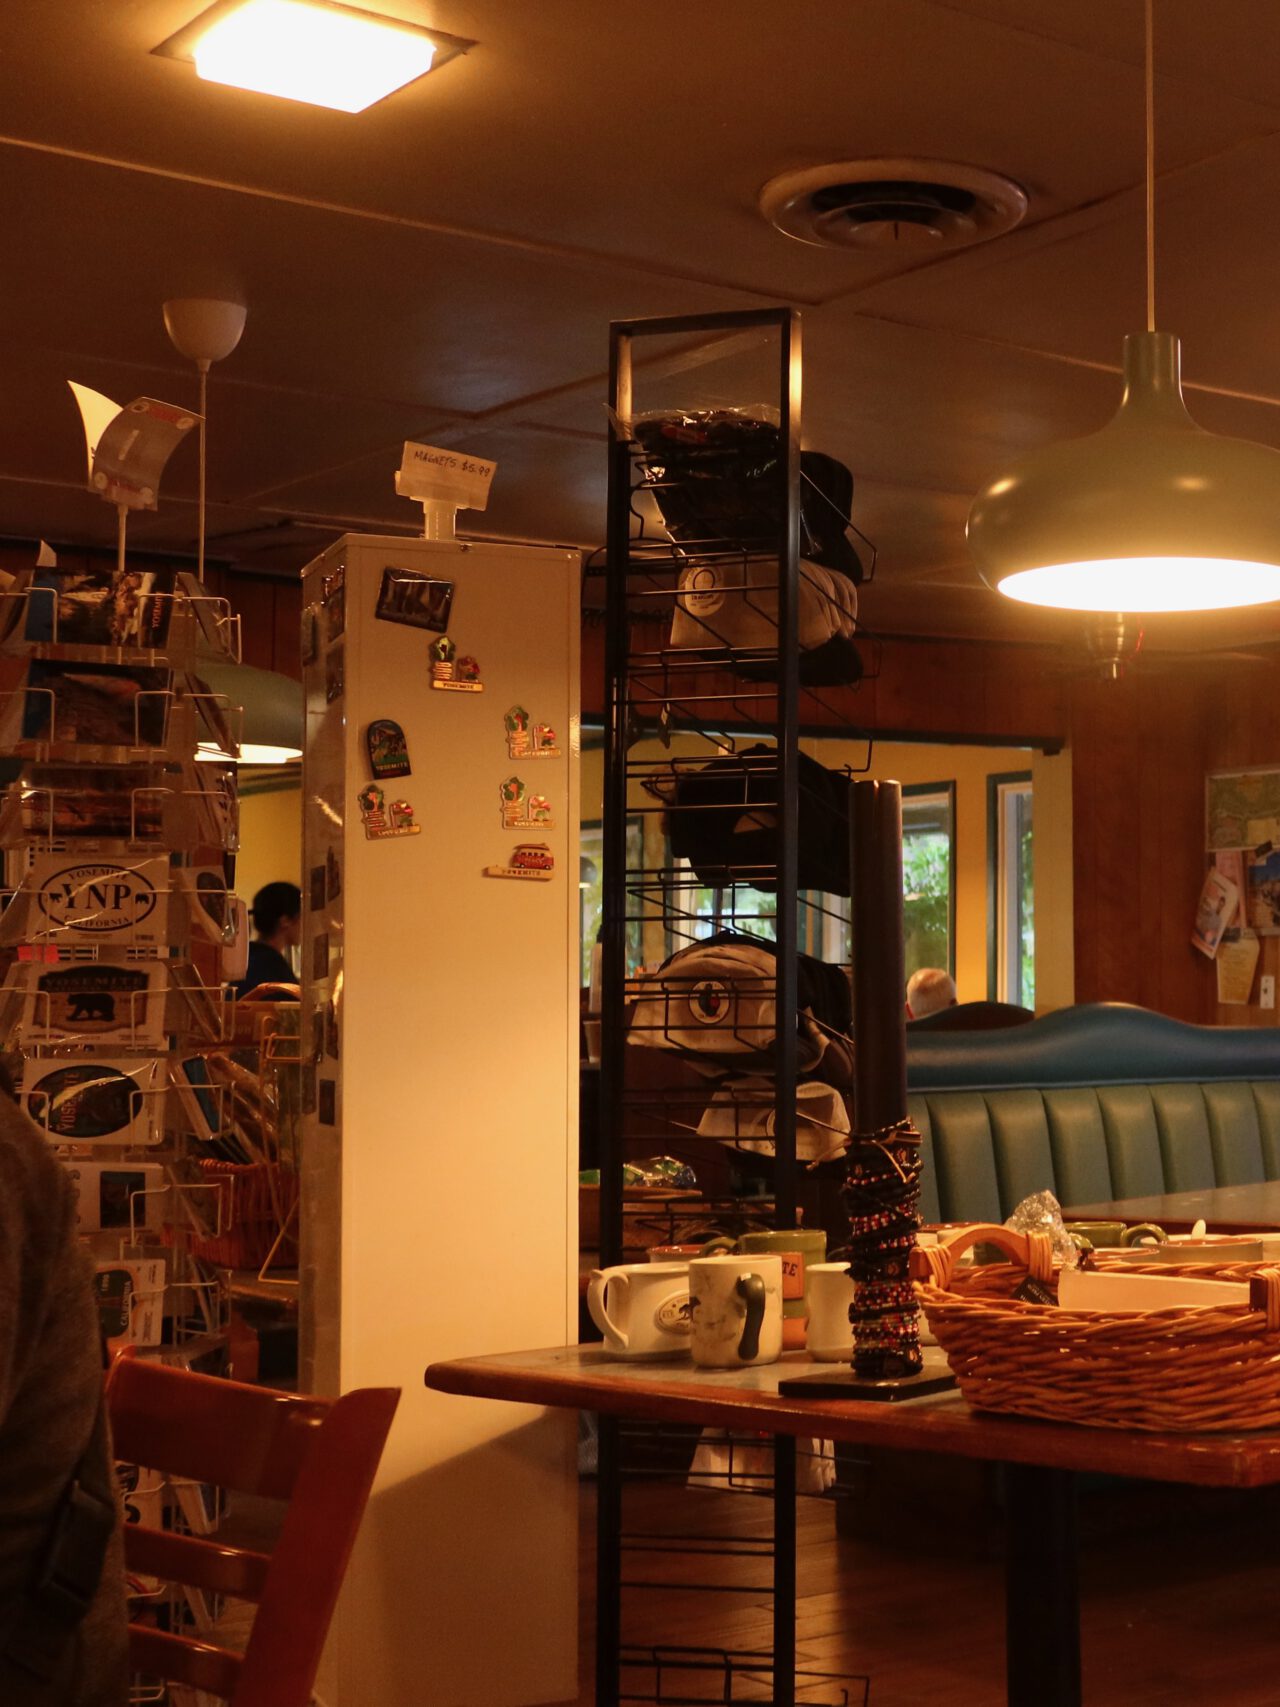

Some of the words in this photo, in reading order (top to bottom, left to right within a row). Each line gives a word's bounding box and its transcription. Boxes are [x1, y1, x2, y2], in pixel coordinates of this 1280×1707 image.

[413, 450, 457, 468] MAGNETS
[461, 459, 491, 478] $5.99
[62, 883, 132, 910] YNP
[45, 976, 144, 986] YOSEMITE
